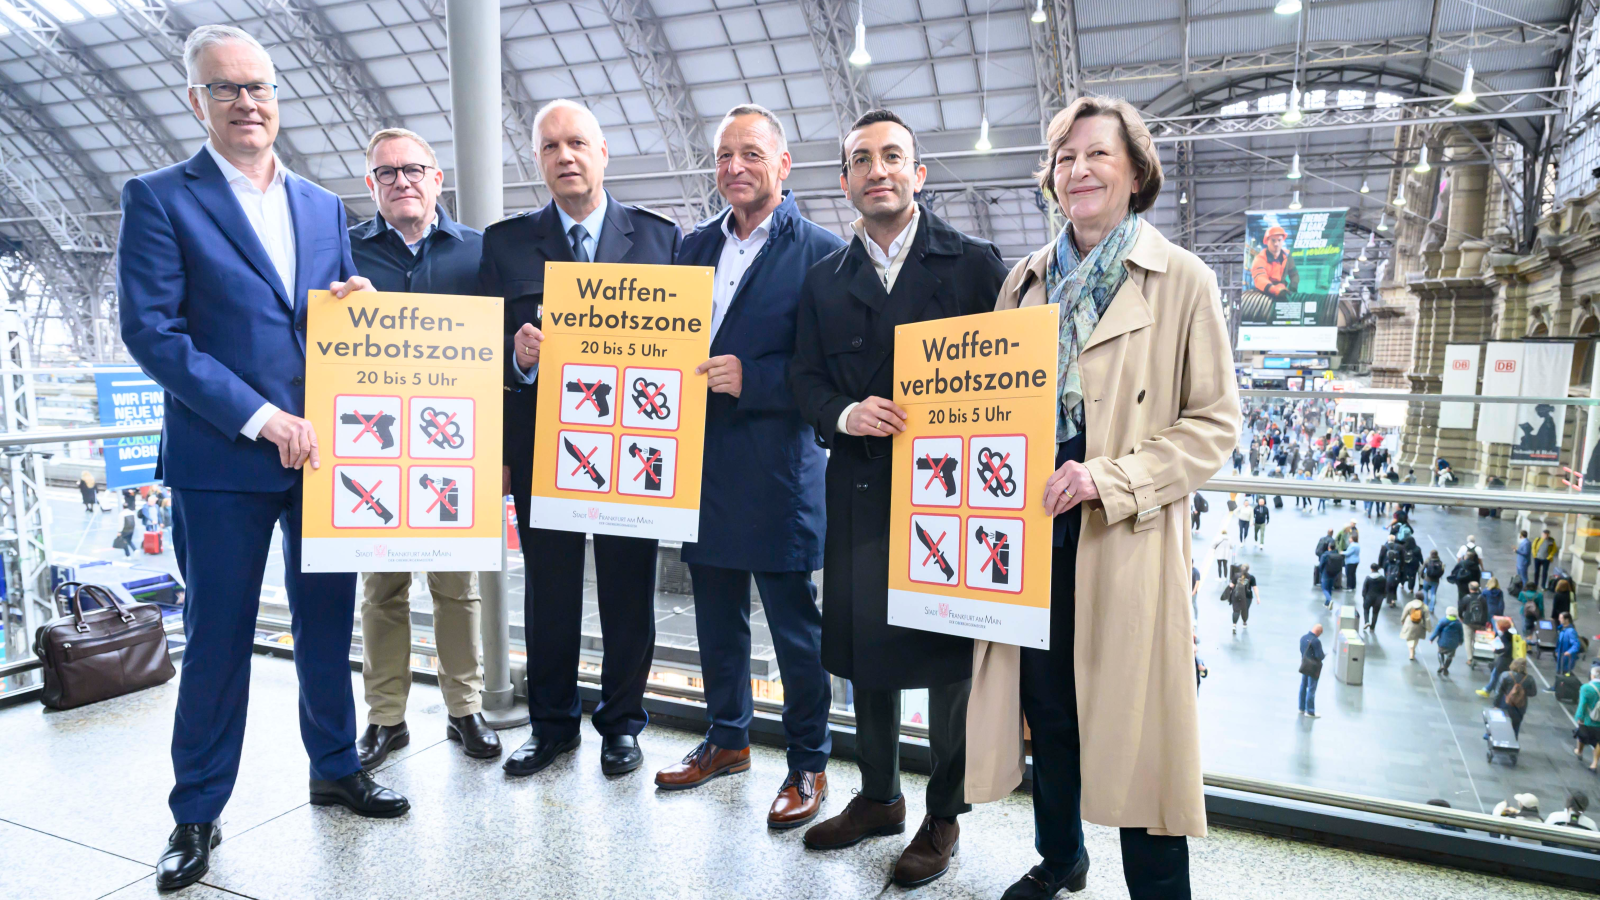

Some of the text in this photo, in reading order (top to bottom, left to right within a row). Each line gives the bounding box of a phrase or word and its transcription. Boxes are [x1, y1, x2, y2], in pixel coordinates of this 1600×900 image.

[576, 278, 677, 302] Waffen-
[348, 307, 464, 331] Waffen-
[550, 305, 701, 332] verbotszone
[317, 334, 493, 361] verbotszone
[581, 341, 667, 357] 20 bis 5 Uhr
[922, 330, 1019, 362] Waffen-
[1497, 361, 1513, 370] DB
[357, 371, 457, 386] 20 bis 5 Uhr
[900, 368, 1046, 396] verbotszone
[112, 392, 164, 406] WIR FIN
[114, 406, 151, 419] NEUE
[929, 406, 1011, 424] 20 bis 5 Uhr
[119, 445, 159, 460] MOBIL
